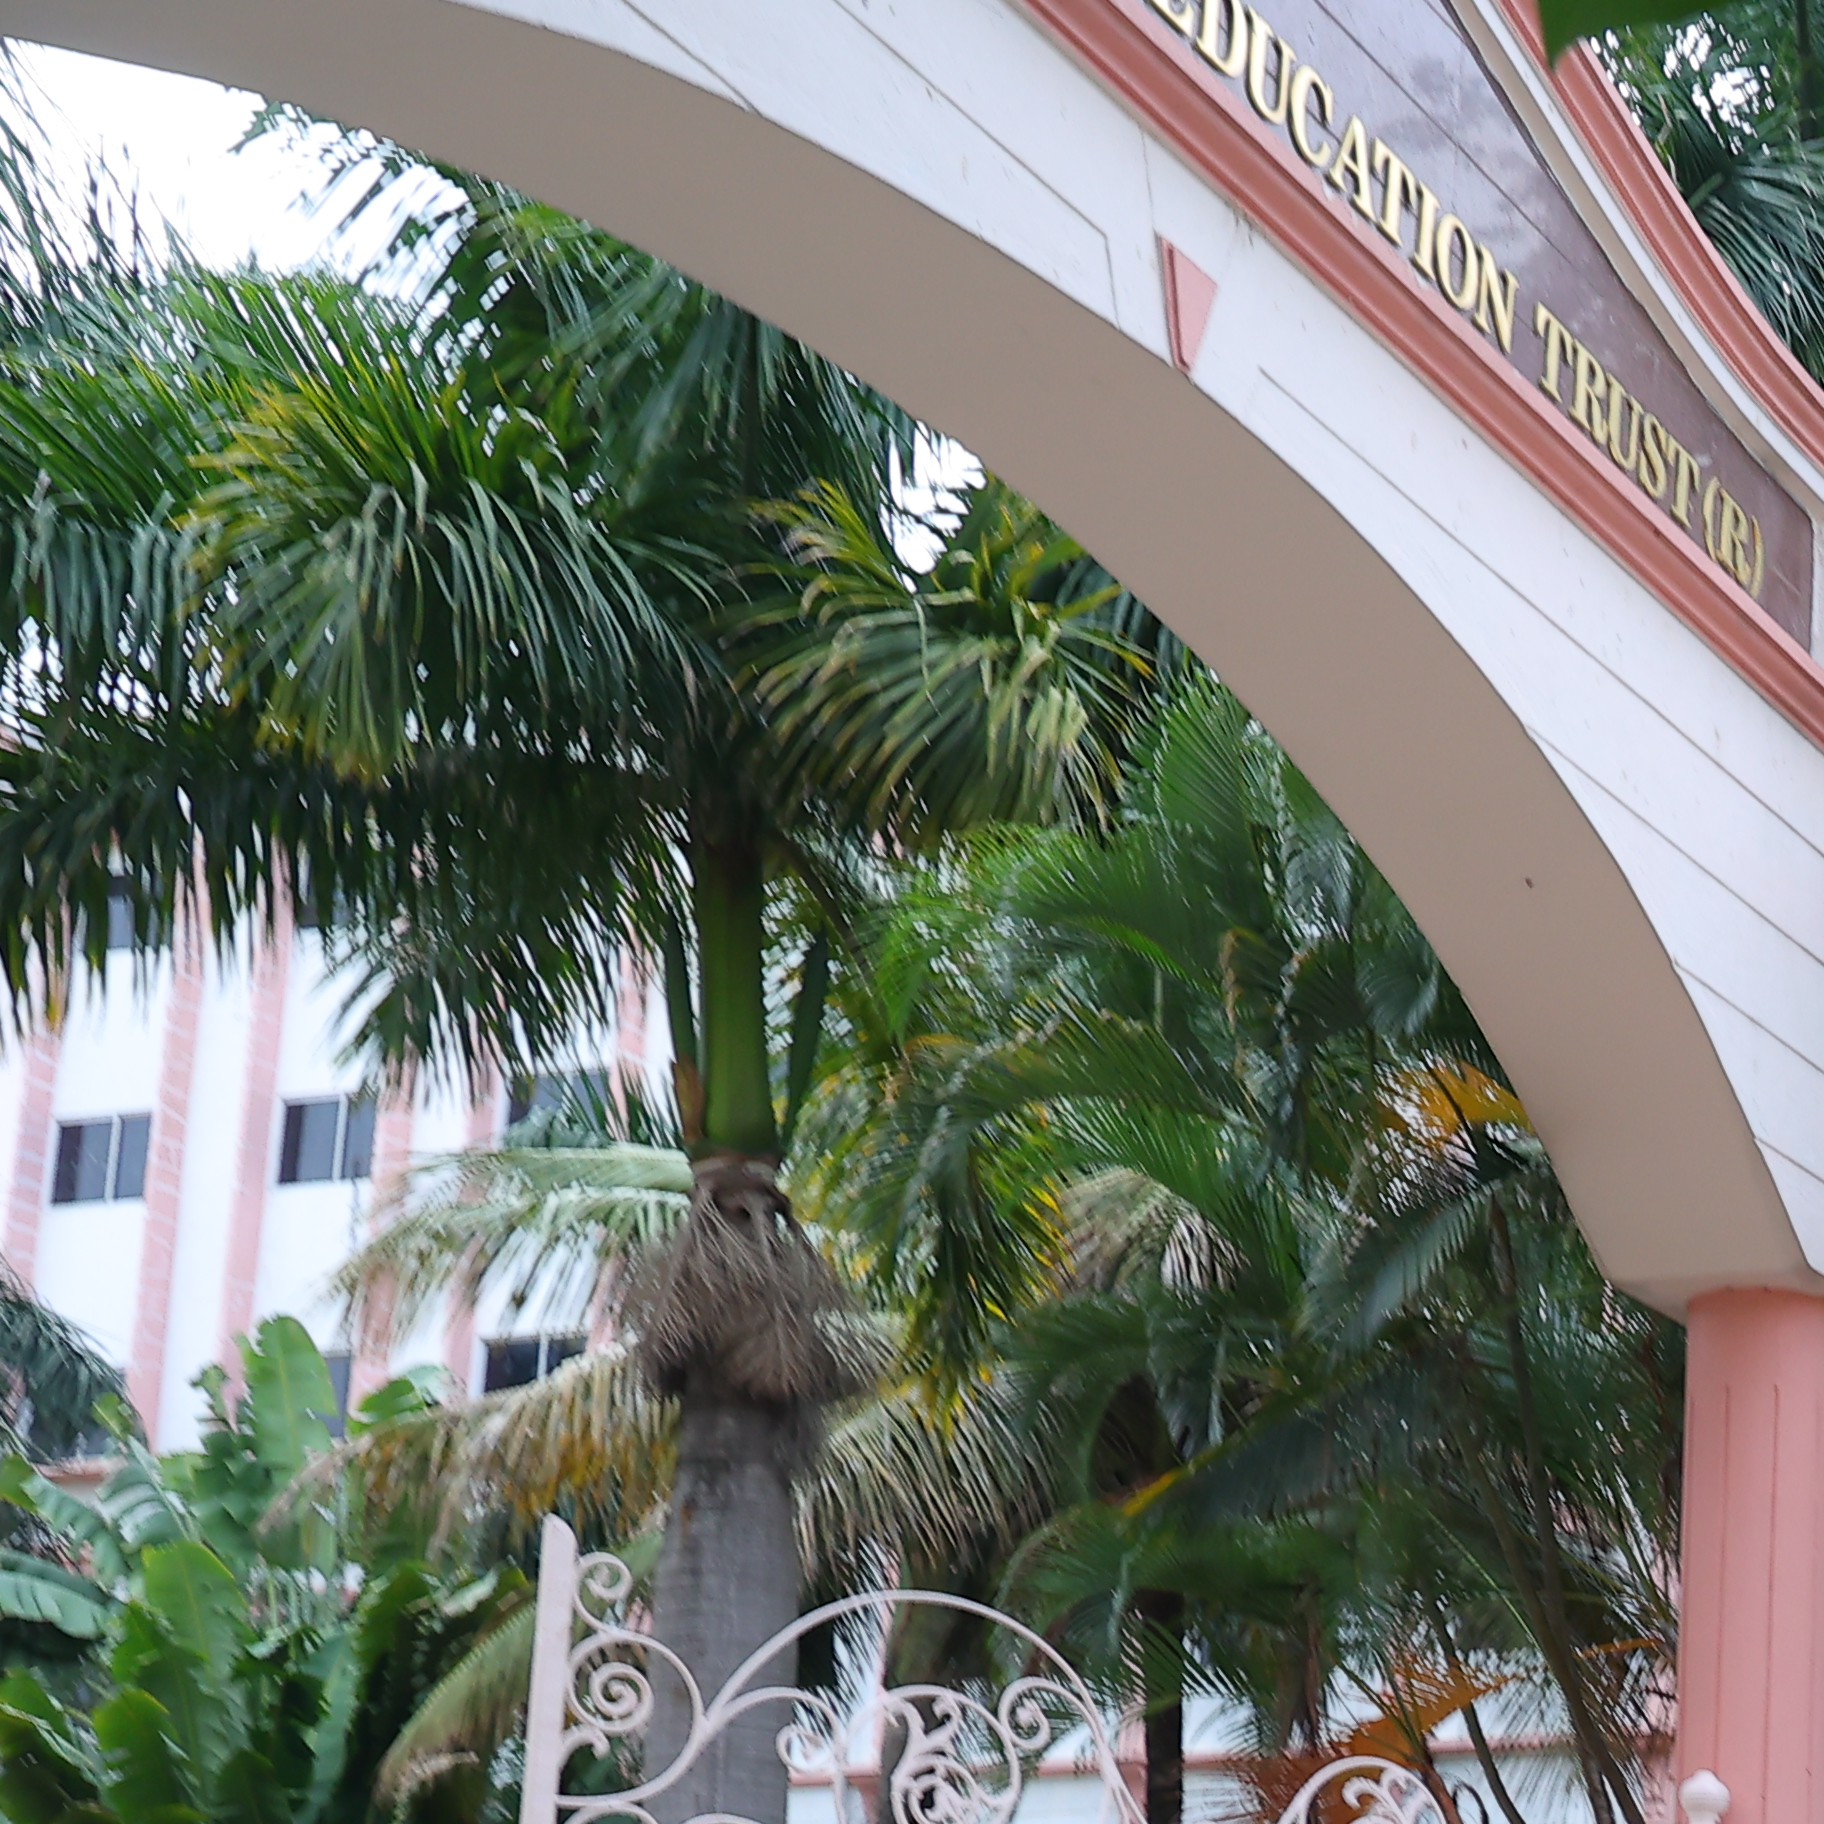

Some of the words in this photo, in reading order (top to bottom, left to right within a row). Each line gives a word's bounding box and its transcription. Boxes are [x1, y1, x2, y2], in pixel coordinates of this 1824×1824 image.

[1150, 0, 1519, 353] DUCATION
[1534, 302, 1700, 529] TRUST
[1703, 477, 1764, 597] (R)
